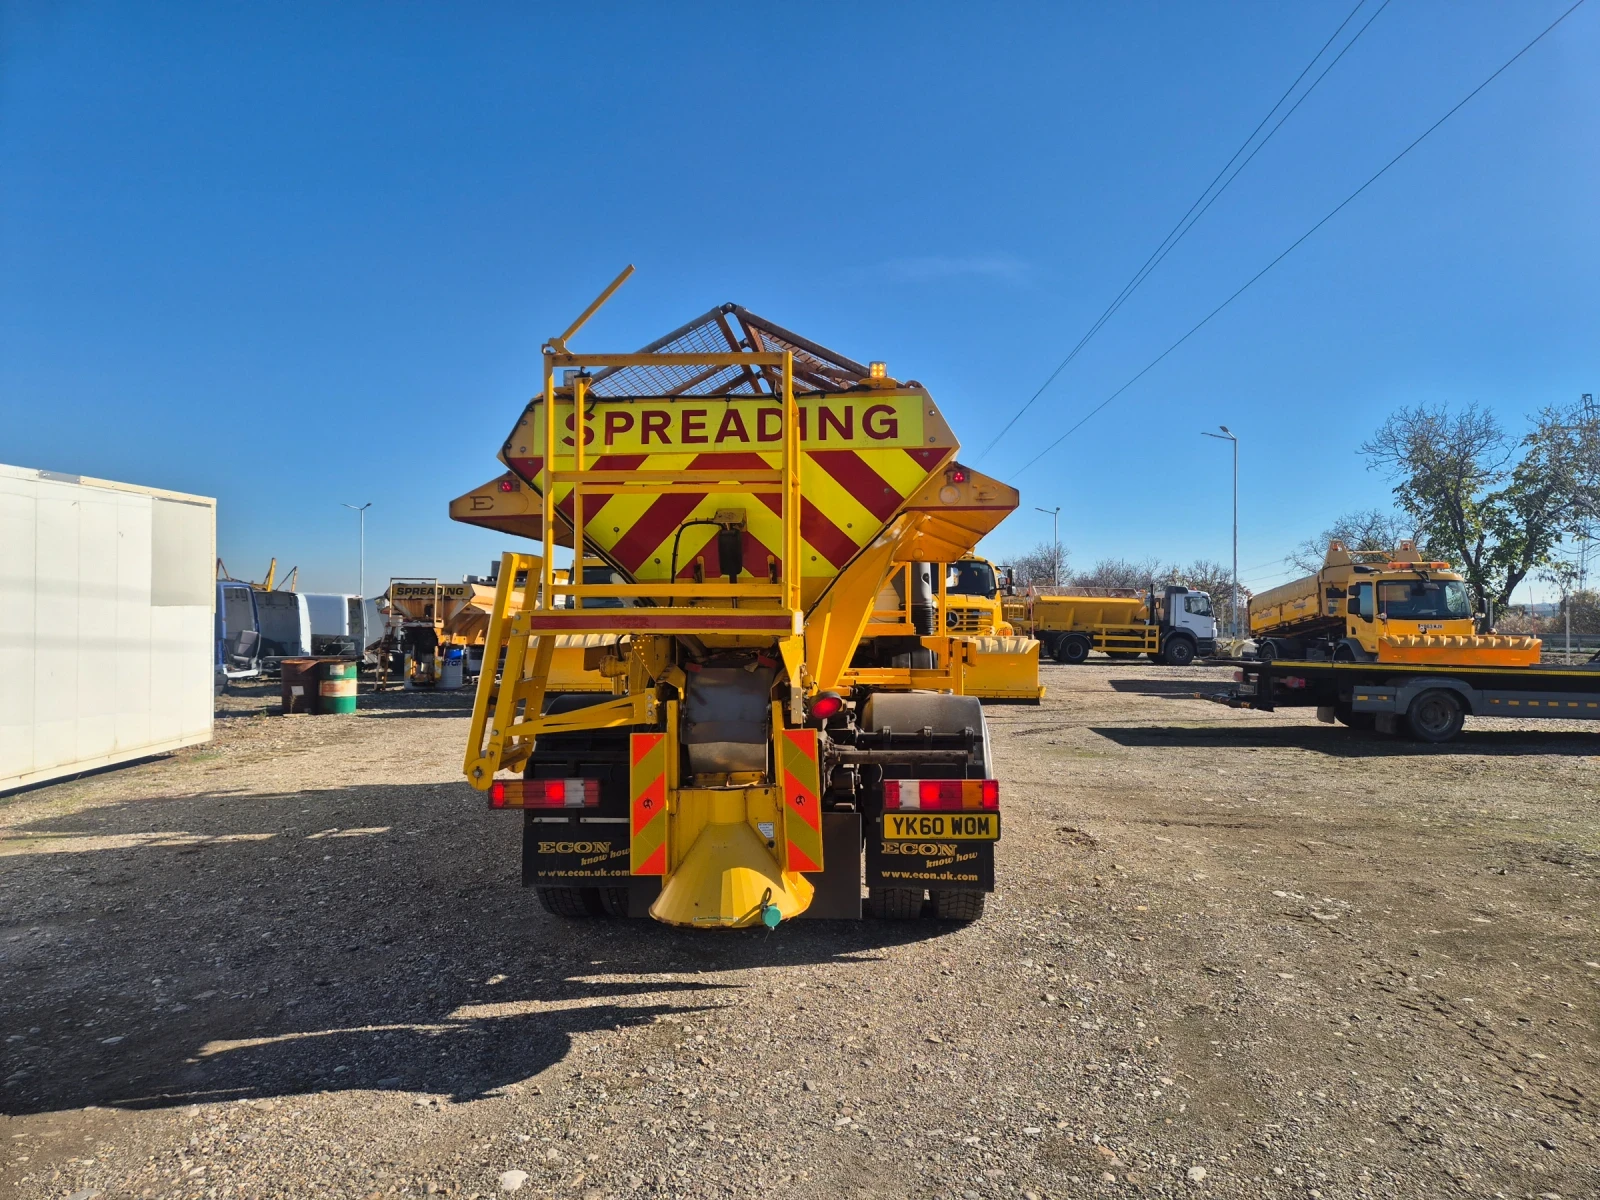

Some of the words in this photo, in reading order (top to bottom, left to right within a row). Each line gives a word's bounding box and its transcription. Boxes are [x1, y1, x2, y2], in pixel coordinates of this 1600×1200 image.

[561, 404, 899, 447] SPREADING
[893, 817, 944, 835] YK60
[537, 842, 611, 854] ECON
[881, 842, 957, 856] ECON
[581, 854, 608, 866] know
[610, 848, 630, 859] how
[926, 857, 953, 869] know
[956, 852, 978, 862] how
[538, 868, 630, 877] www.econ.uk.com
[881, 871, 978, 881] www.econ.uk.com
